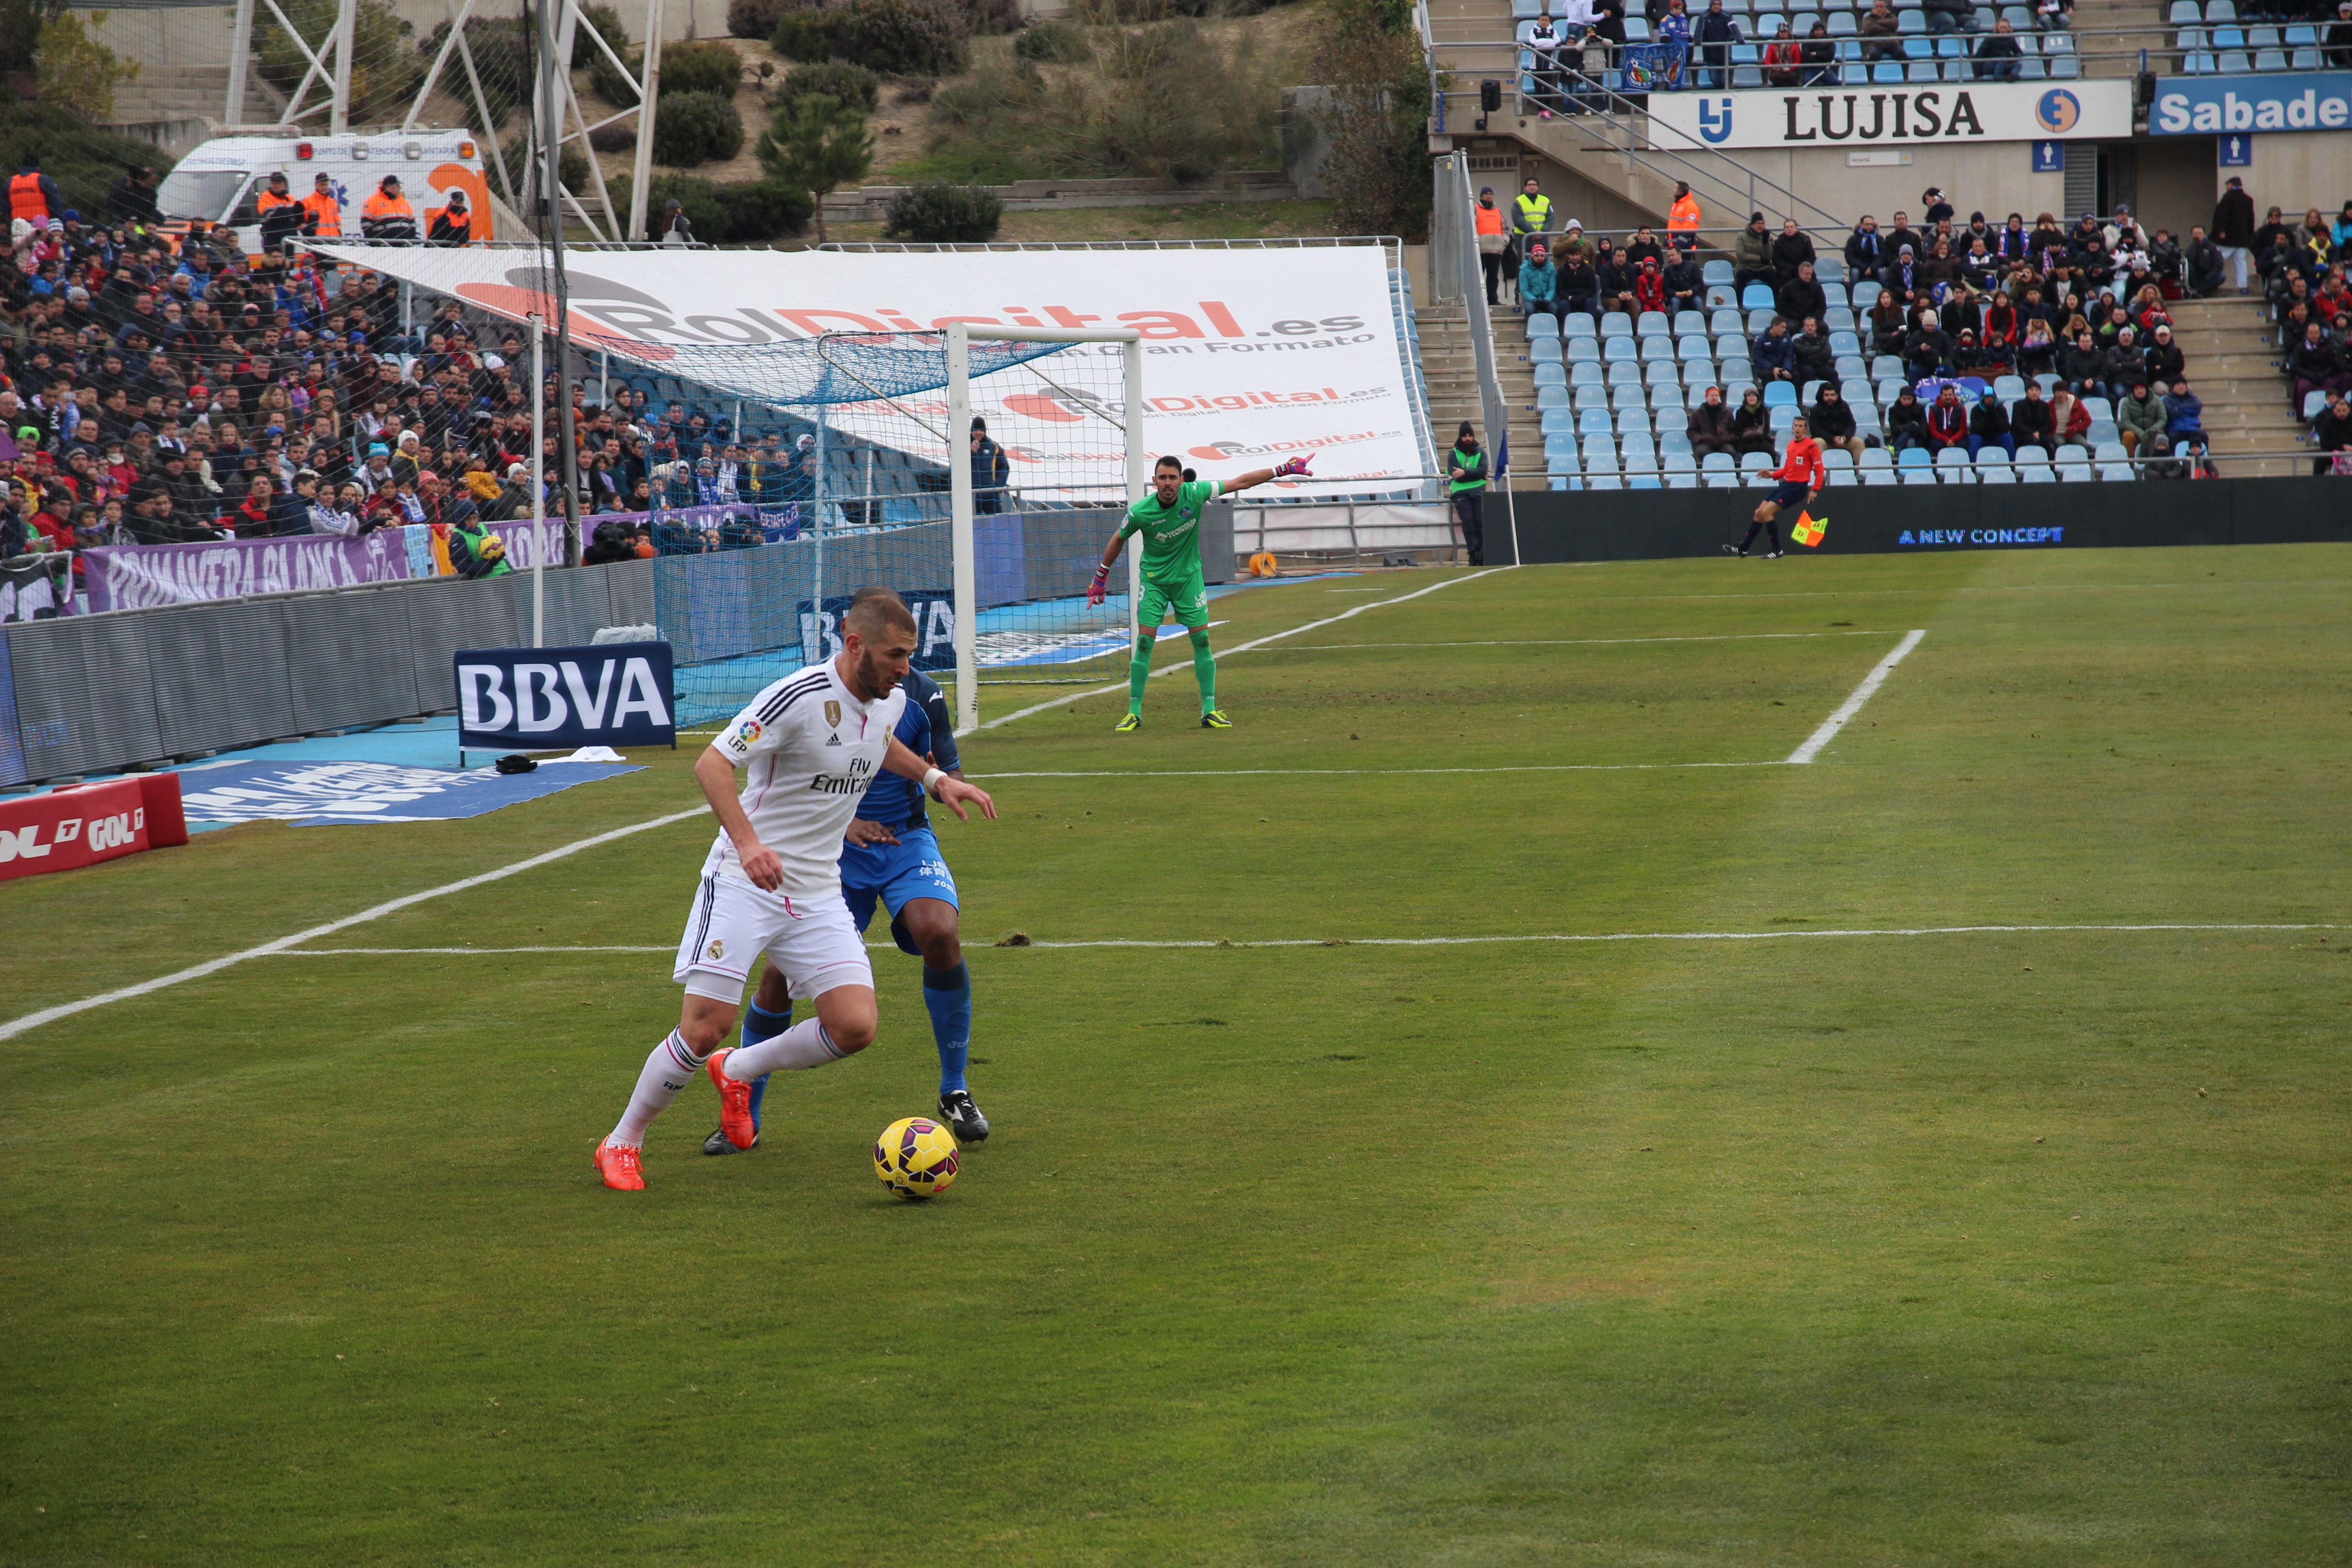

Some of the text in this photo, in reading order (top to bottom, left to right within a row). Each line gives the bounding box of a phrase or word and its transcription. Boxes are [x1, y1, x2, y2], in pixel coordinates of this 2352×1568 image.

[1784, 92, 1984, 140] LUJISA
[2158, 89, 2352, 132] Sabade
[1204, 333, 1376, 354] Formato
[1170, 409, 1220, 417] Digital
[1323, 393, 1392, 406] Formato
[1220, 430, 1402, 456] RolDigital.es
[1899, 526, 2064, 544] A NEW CONCEPT
[263, 541, 359, 595] BLANCA
[458, 657, 671, 732] BBVA
[727, 735, 747, 753] LFP
[849, 757, 871, 774] Fly
[88, 813, 135, 852] GOL
